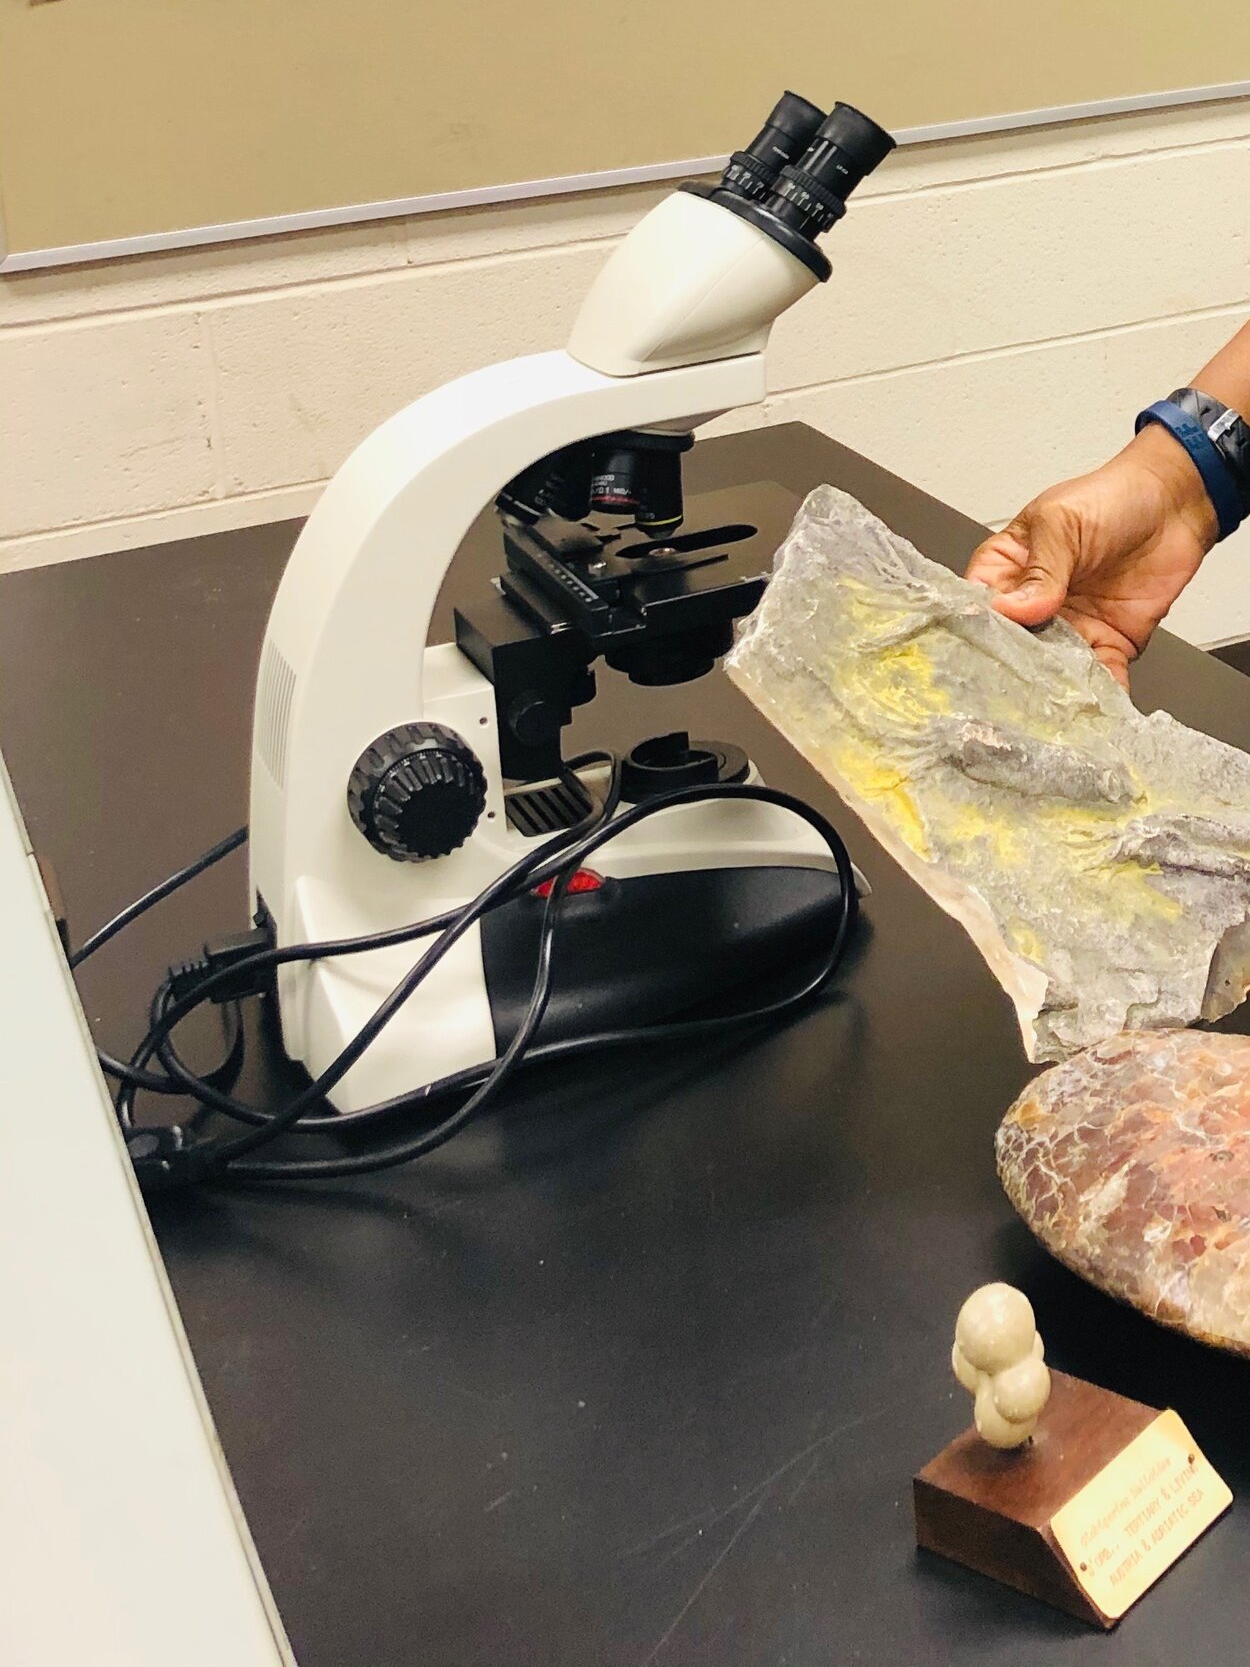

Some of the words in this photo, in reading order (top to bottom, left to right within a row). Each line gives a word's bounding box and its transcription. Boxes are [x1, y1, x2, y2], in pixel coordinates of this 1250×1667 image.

[1109, 1549, 1144, 1587] AUSTRIA
[1140, 1538, 1151, 1551] &
[1151, 1503, 1188, 1546] ADRIATIC
[1187, 1487, 1205, 1508] SEA
[1124, 1497, 1162, 1537] TERTIARY
[1160, 1487, 1171, 1501] &
